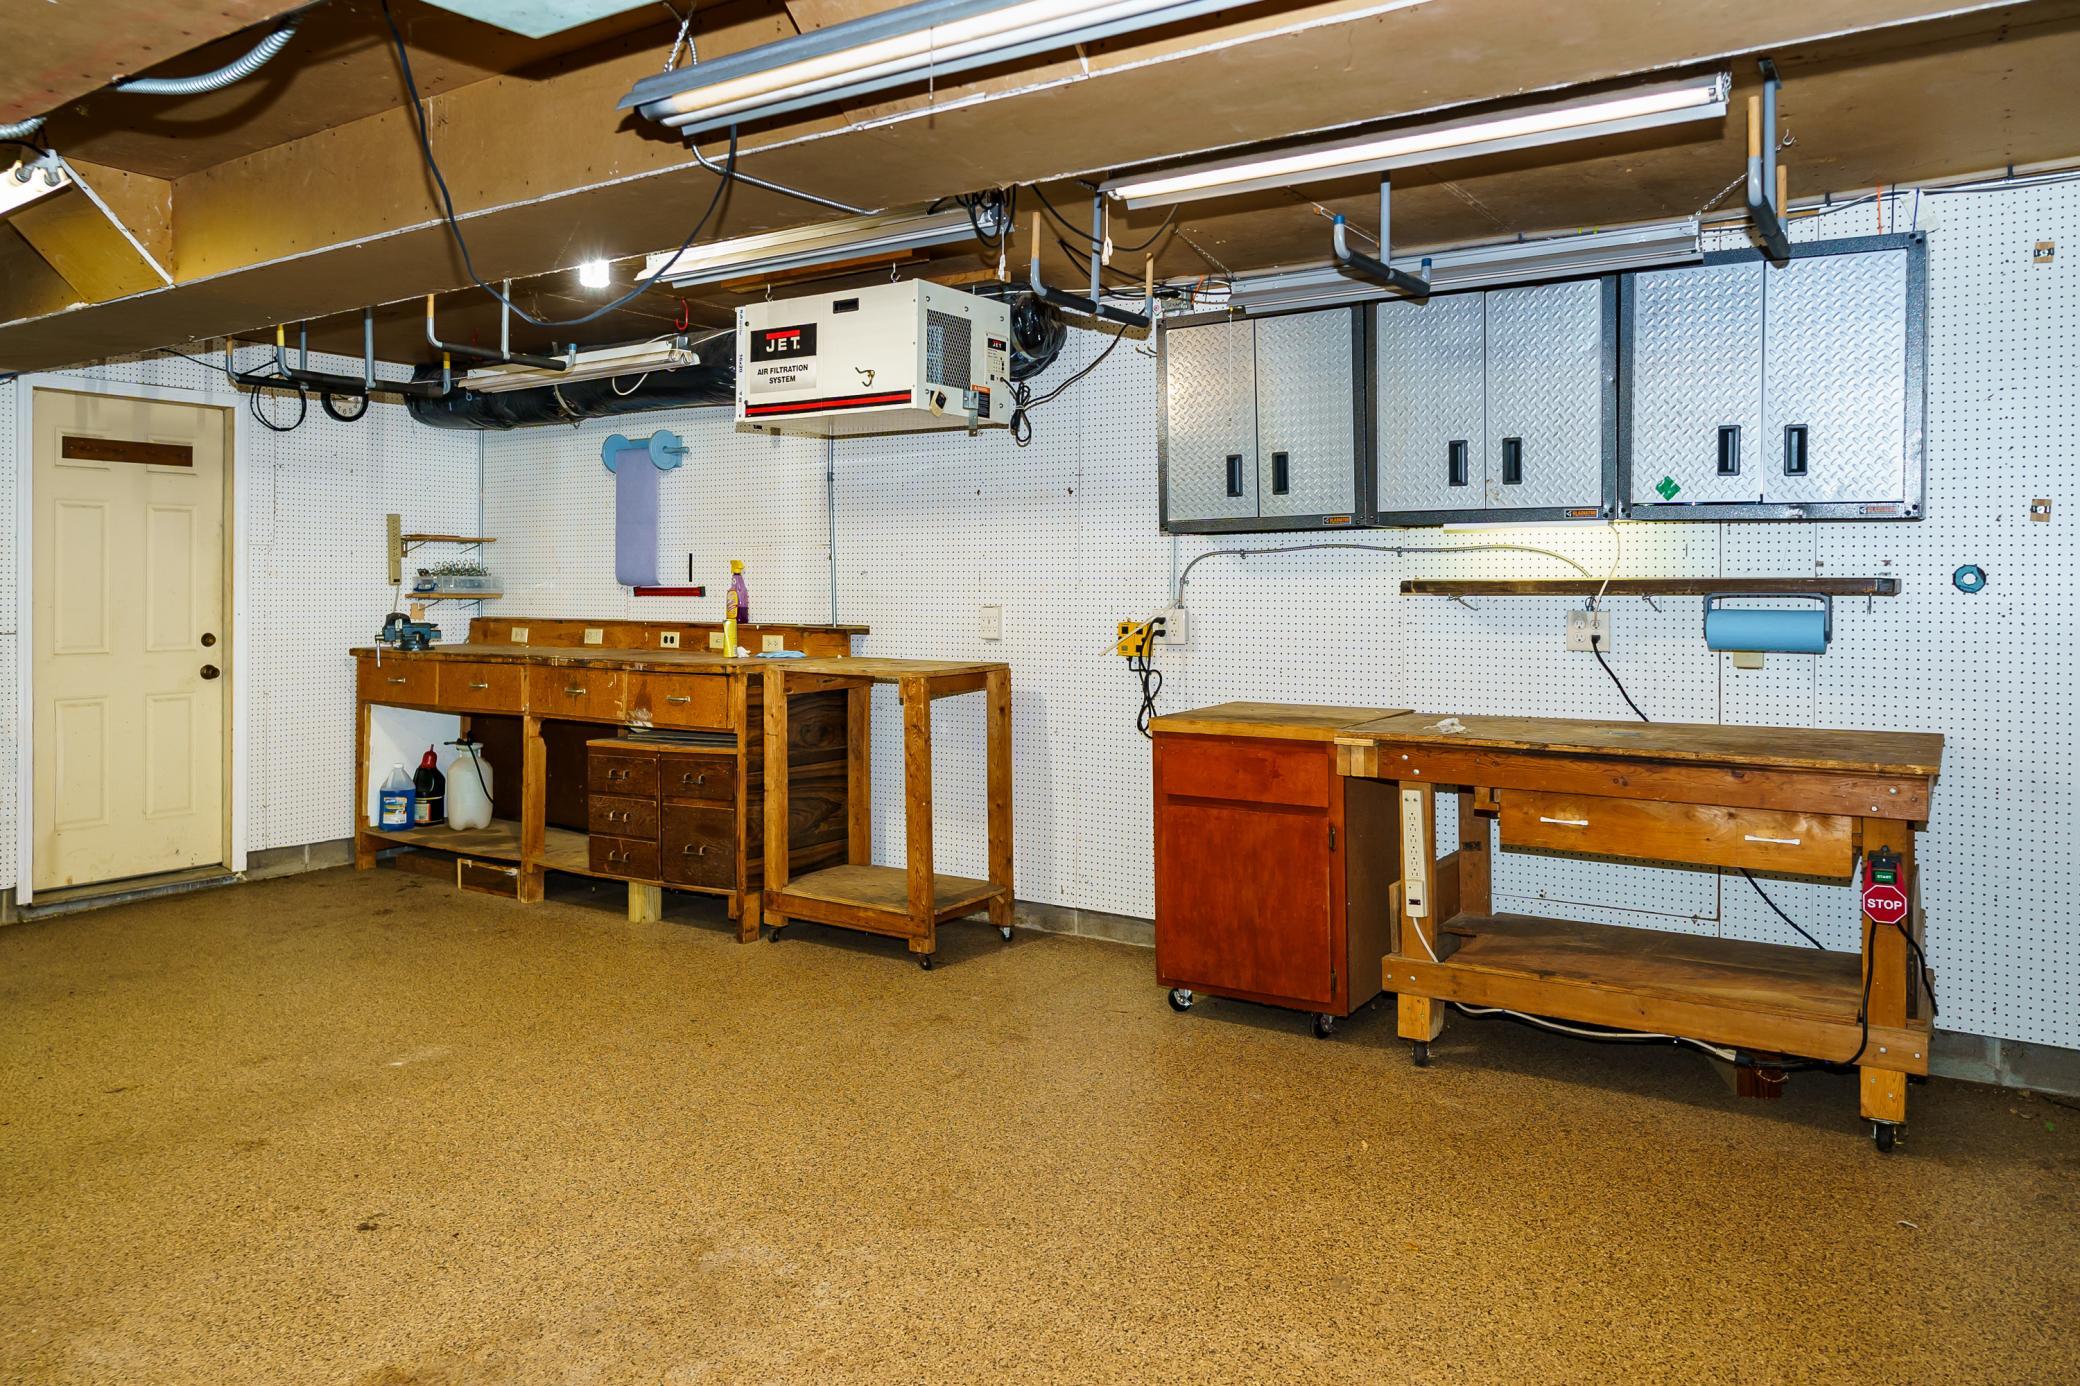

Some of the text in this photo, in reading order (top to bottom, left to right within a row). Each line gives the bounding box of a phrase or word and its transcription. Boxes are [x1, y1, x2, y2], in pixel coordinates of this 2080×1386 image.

[766, 336, 800, 352] JET
[757, 364, 809, 376] AIR FILTRATION
[769, 375, 796, 384] SYSTEM
[1867, 899, 1902, 910] STOP
